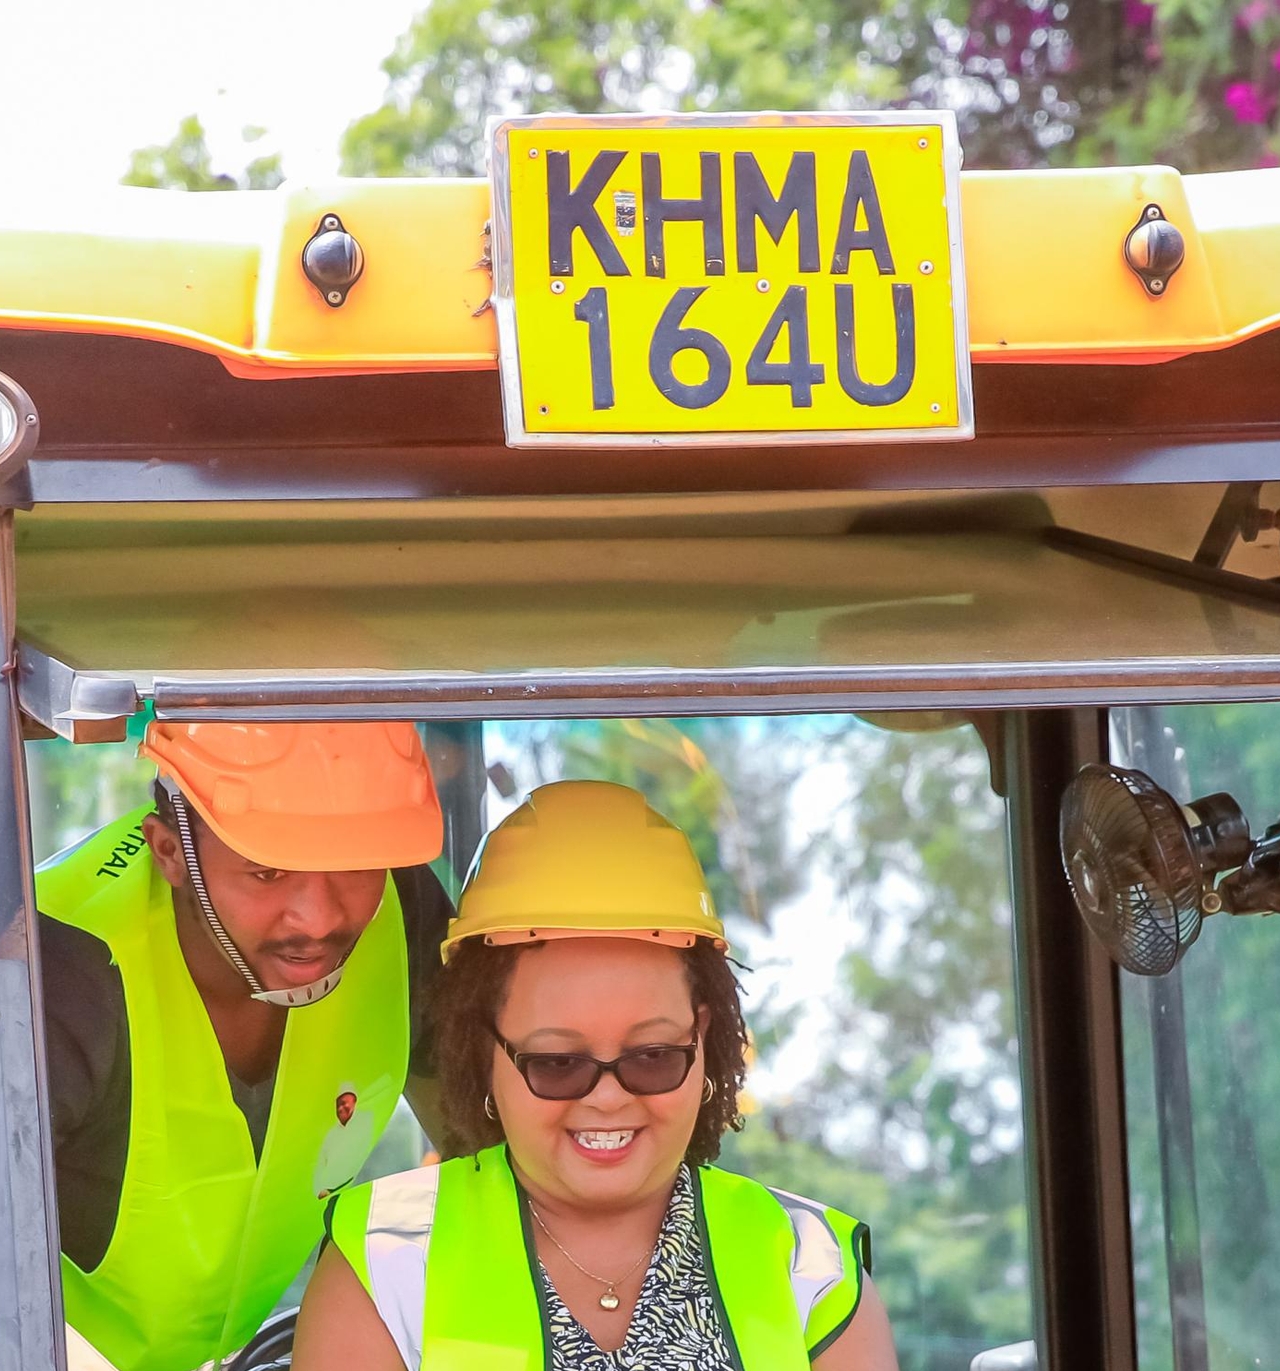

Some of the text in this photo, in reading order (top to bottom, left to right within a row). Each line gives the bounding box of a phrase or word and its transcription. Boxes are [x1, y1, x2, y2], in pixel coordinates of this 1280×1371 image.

[545, 148, 896, 278] KHMA
[574, 283, 916, 410] 164U
[95, 820, 148, 878] TRAL
